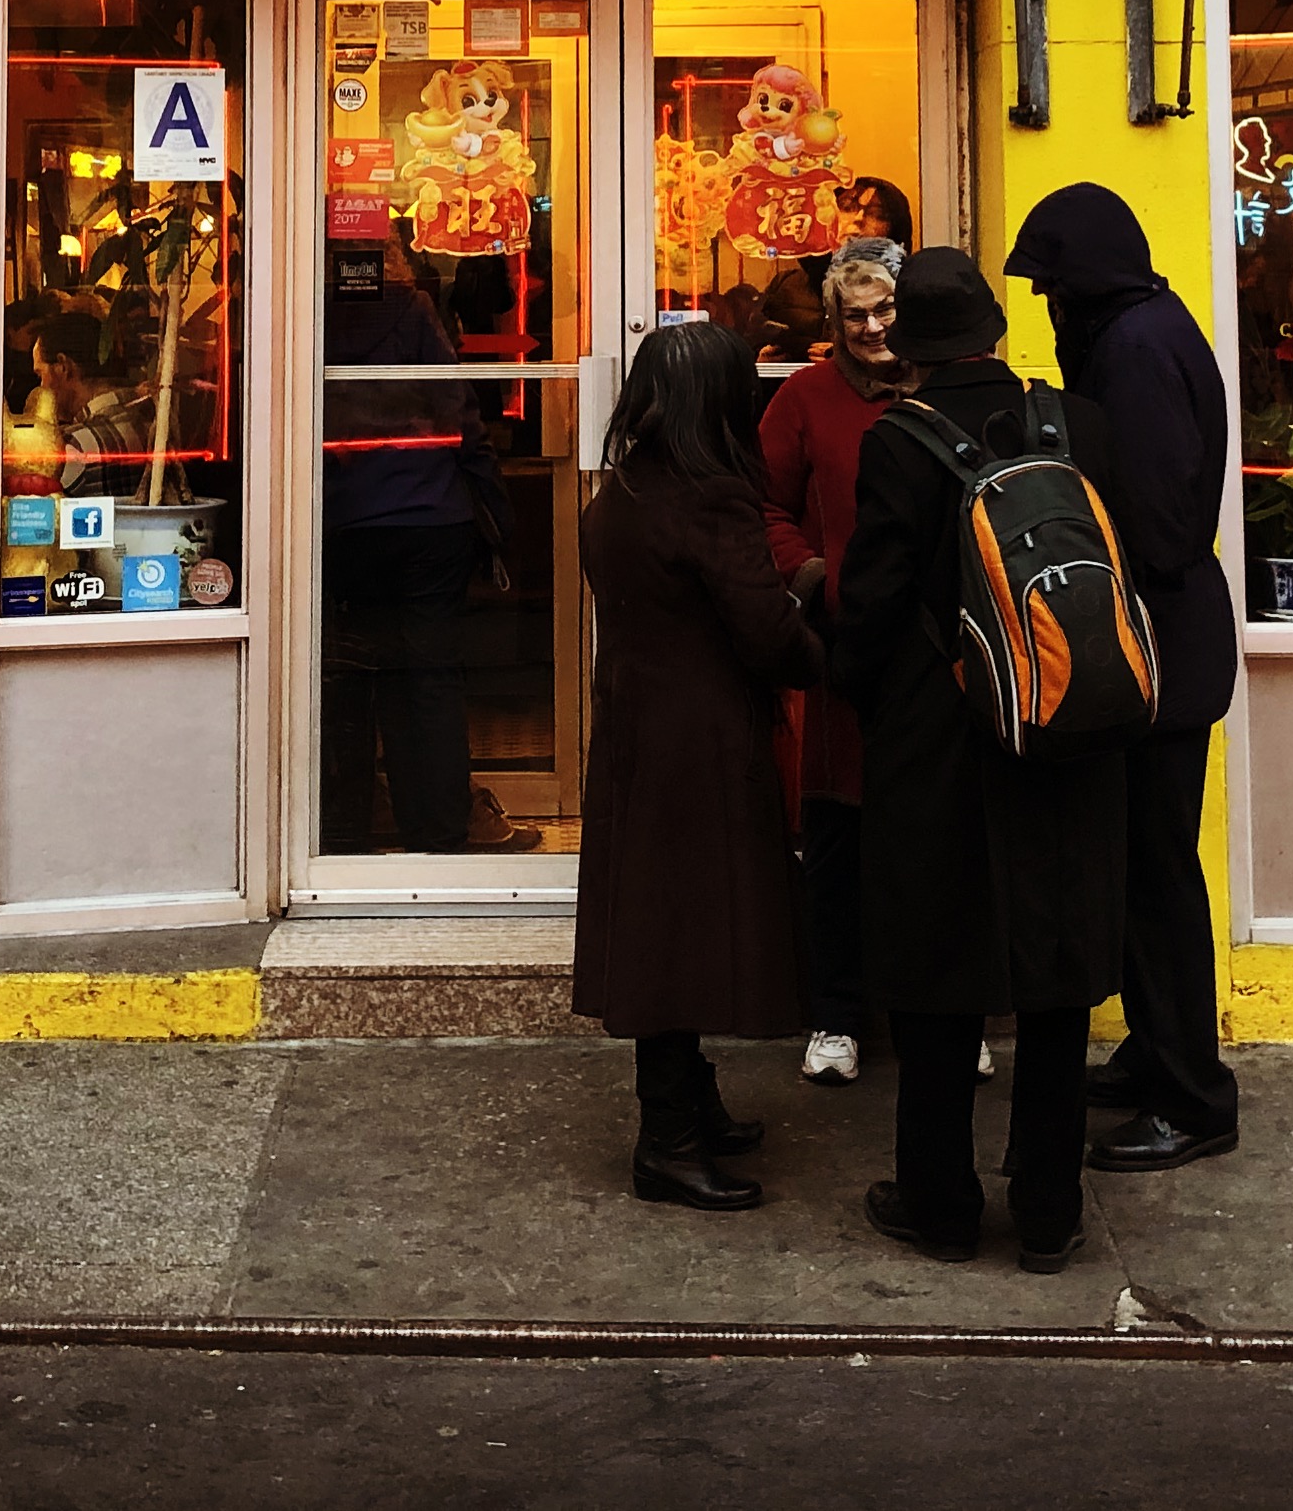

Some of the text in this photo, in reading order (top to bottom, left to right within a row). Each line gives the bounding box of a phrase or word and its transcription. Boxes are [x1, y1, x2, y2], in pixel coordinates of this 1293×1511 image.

[400, 21, 427, 34] TSB
[148, 82, 210, 148] A
[334, 199, 385, 211] ZAGAT
[447, 185, 503, 238] 旺
[756, 187, 813, 243] 福
[334, 213, 361, 224] 2017
[662, 312, 684, 324] Pull
[69, 571, 87, 579] Free
[194, 582, 216, 593] yelp
[70, 599, 87, 608] spot
